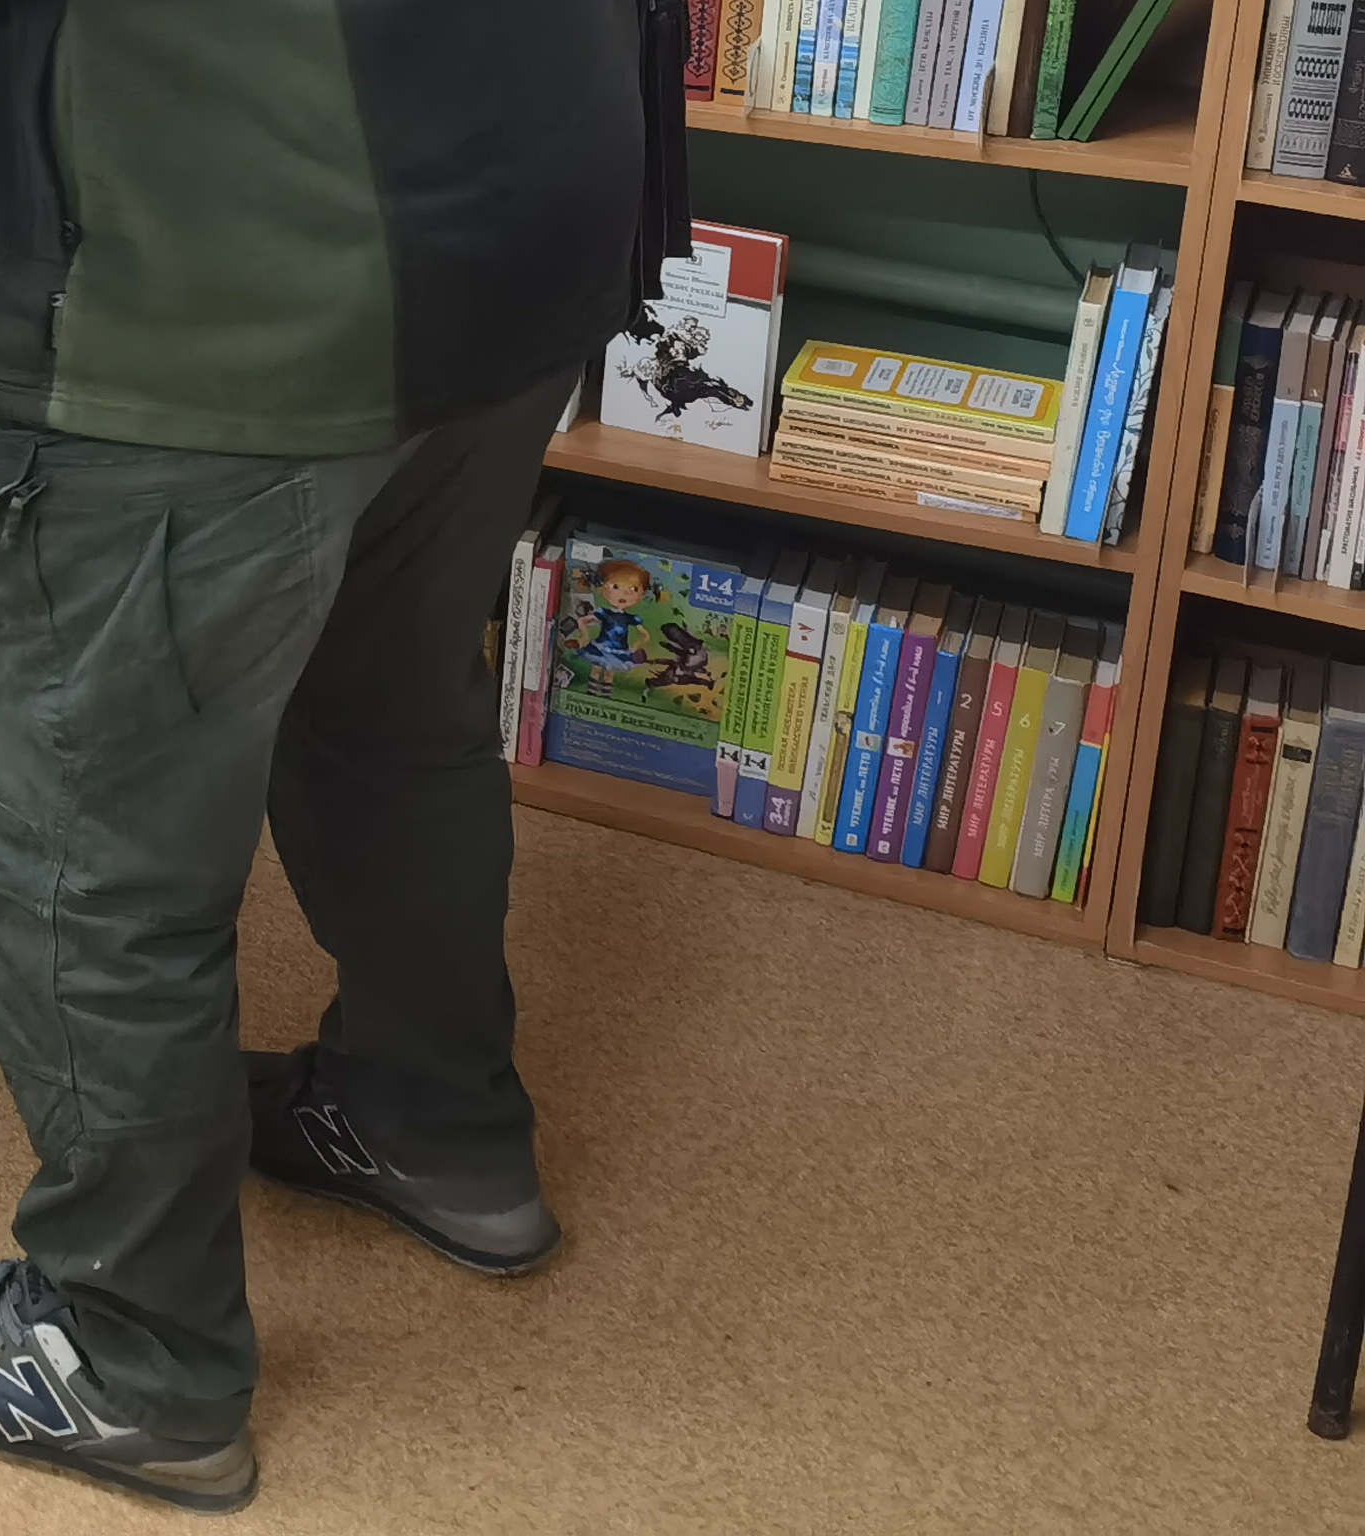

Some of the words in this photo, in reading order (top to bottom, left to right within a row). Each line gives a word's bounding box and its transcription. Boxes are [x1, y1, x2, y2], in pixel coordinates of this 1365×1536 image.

[698, 574, 735, 596] 1-4
[960, 692, 973, 709] 2
[990, 701, 1003, 716] 5
[1049, 721, 1066, 736] 7
[743, 753, 767, 770] 1-4
[916, 726, 940, 799] ЛИТЕРАТУРЫ
[942, 728, 967, 802] ЛИТЕРАТУРЫ
[972, 738, 996, 810] ЛИТЕРАТУРЫ
[849, 789, 865, 827] ЧТЕНИЕ
[857, 752, 871, 779] ЛЕТО
[881, 796, 897, 834] ЧТЕНИЕ
[890, 759, 904, 785] ЛЕТО
[1001, 748, 1025, 820] ЛИТЕРАТУРЫ
[1037, 756, 1060, 830] ЛИТЕРАУРЫ
[769, 796, 786, 824] 3-4
[912, 801, 926, 826] МИР
[936, 805, 951, 830] МИР
[966, 813, 979, 838] МИР
[1032, 833, 1046, 858] МИР
[293, 1104, 380, 1175] N
